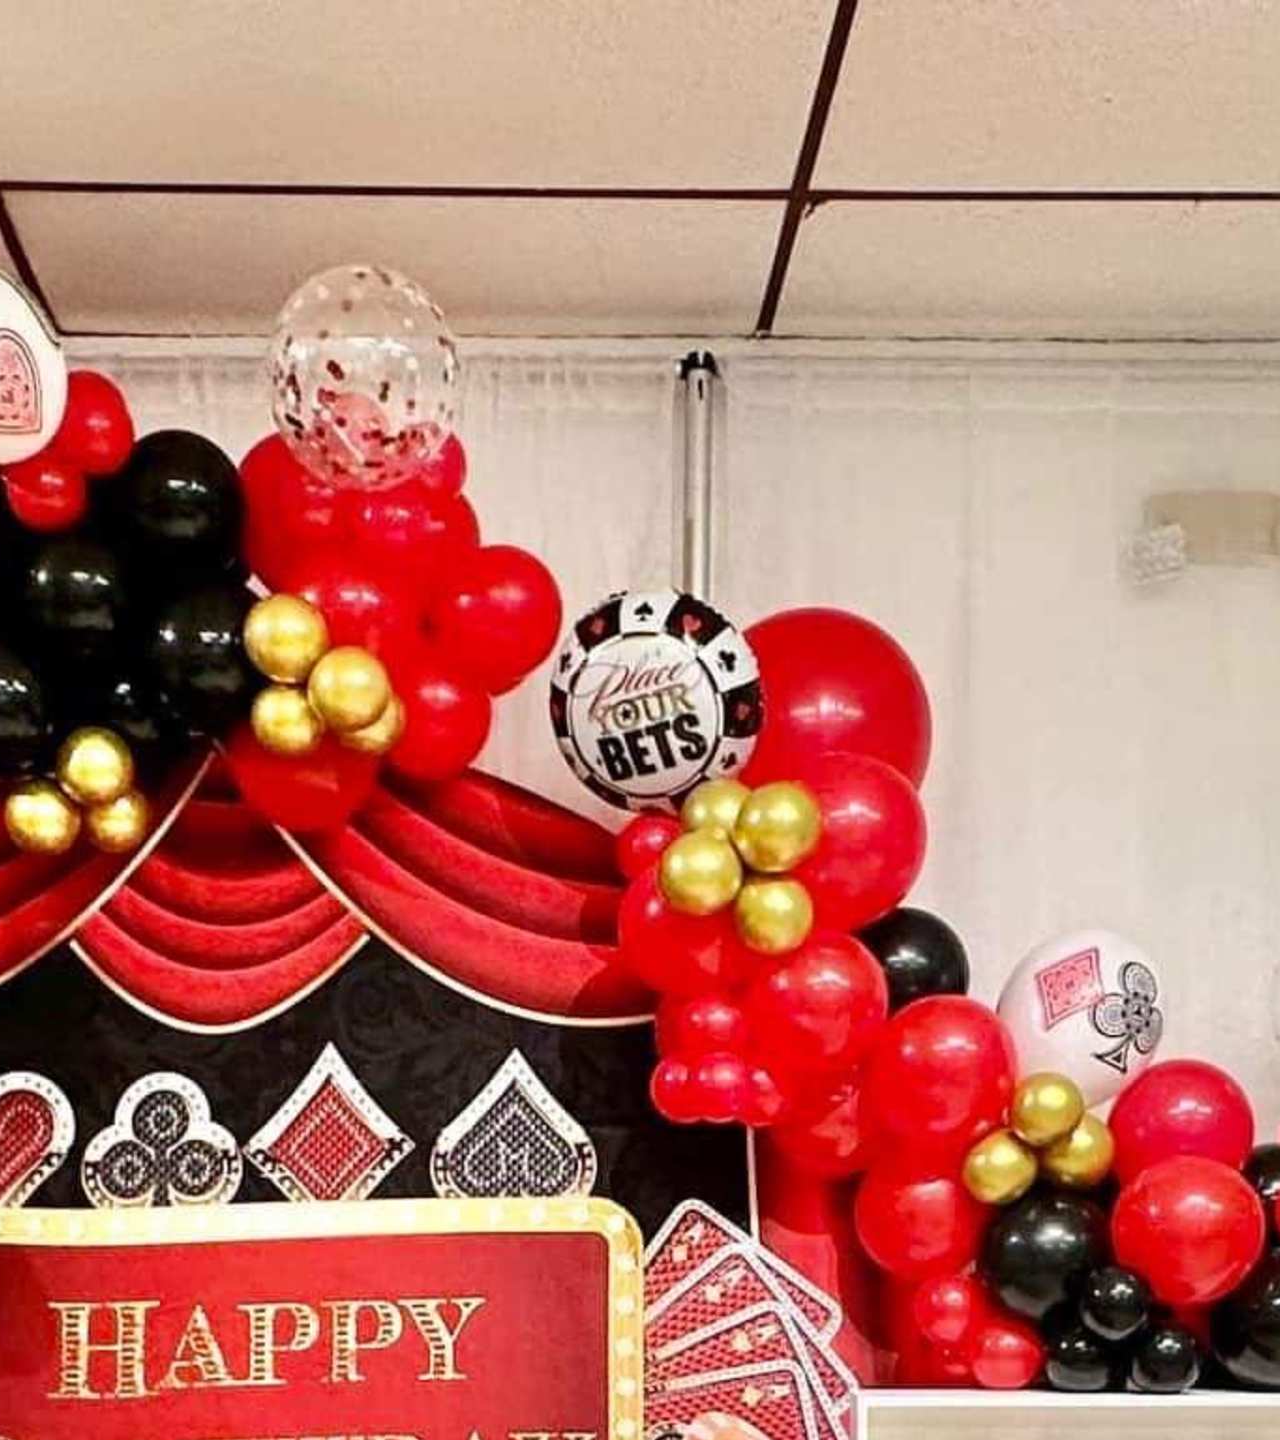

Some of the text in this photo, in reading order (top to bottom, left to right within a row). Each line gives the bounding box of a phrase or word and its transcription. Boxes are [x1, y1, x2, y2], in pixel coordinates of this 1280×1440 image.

[580, 656, 696, 716] Place
[592, 683, 695, 735] YOUR
[597, 713, 708, 781] BETS
[45, 1295, 487, 1400] HAPPY
